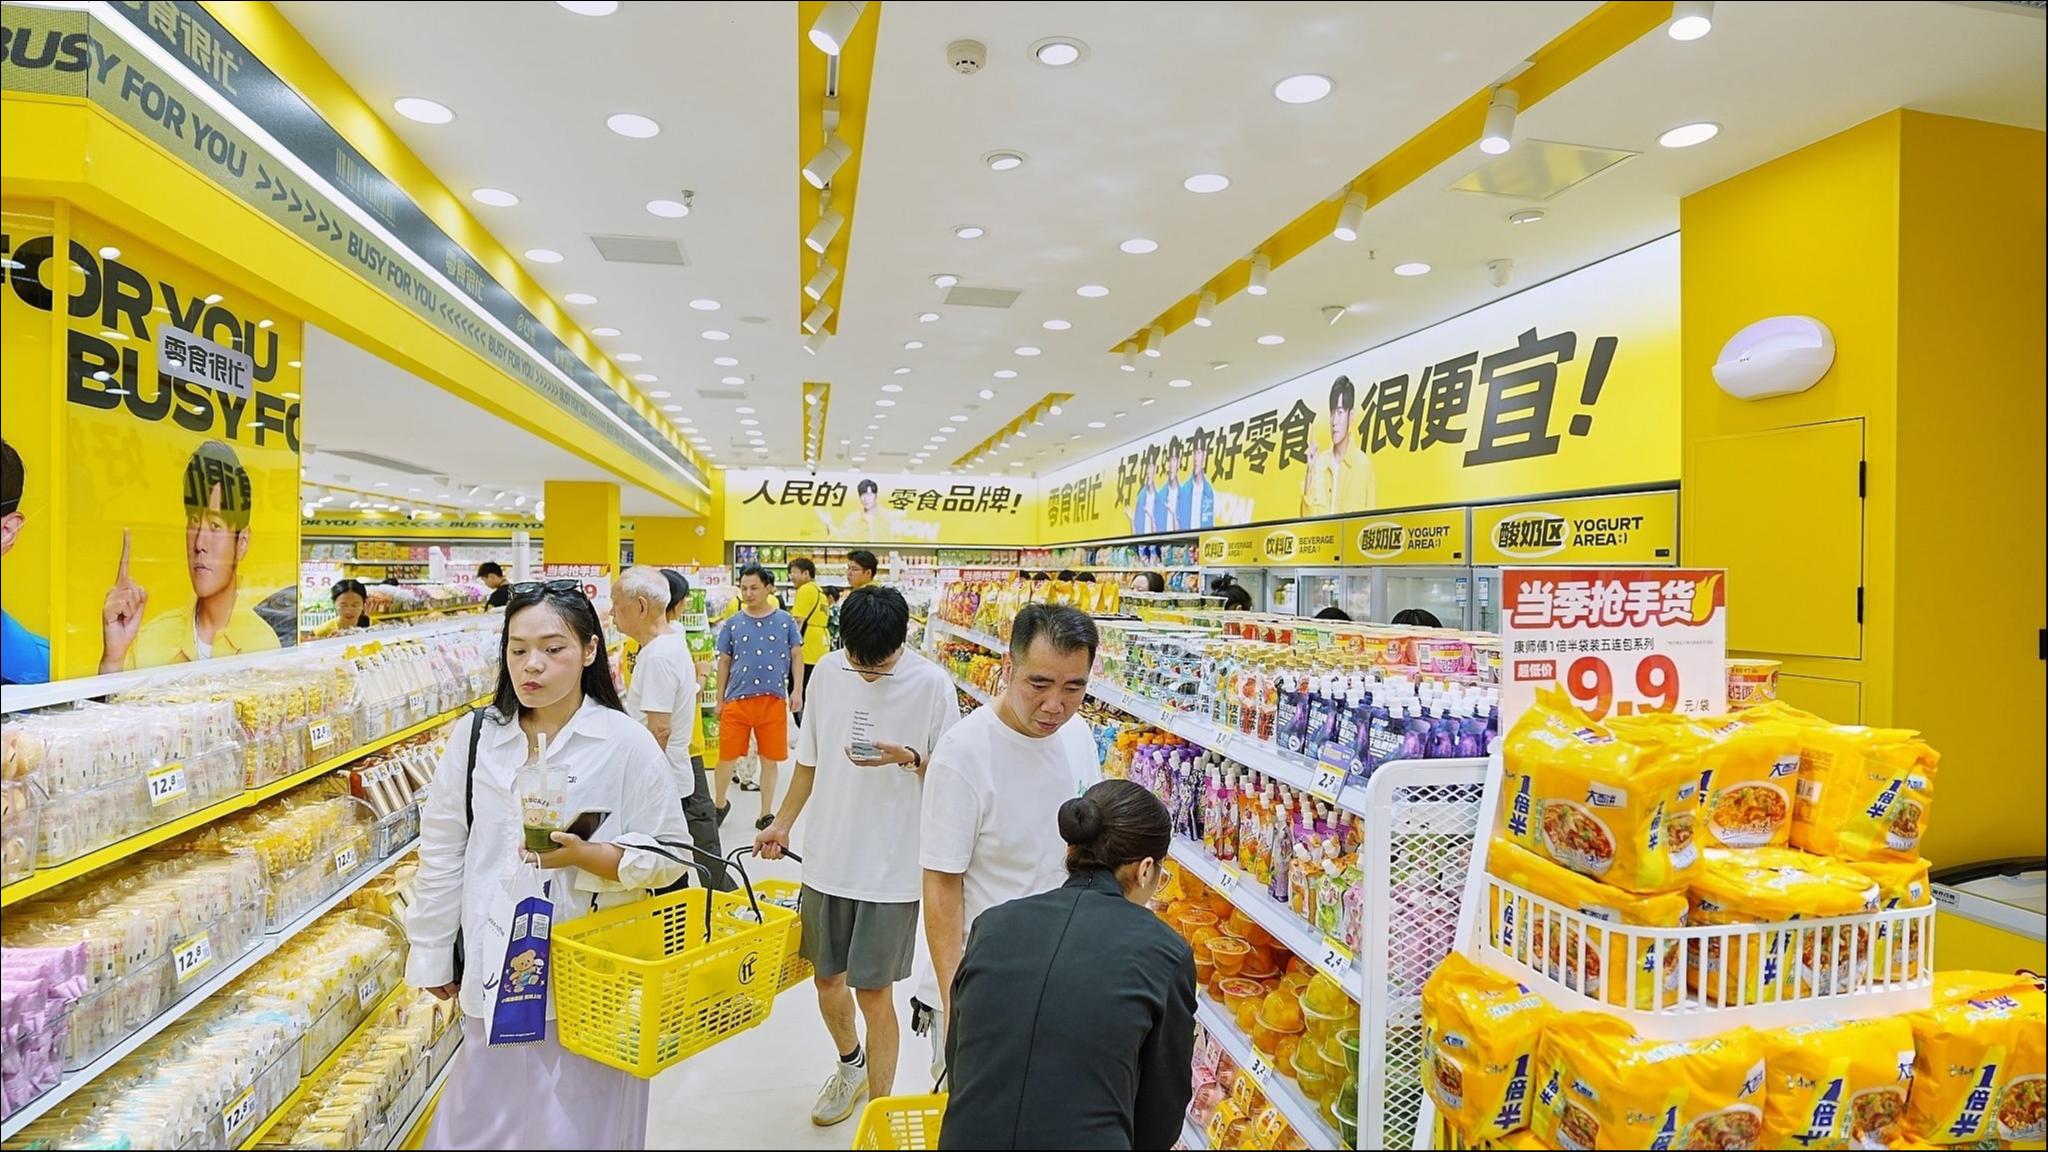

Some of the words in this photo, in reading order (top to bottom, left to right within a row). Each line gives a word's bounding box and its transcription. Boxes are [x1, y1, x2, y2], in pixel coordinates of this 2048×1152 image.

[120, 1, 240, 96] 食很忙
[0, 26, 121, 84] USY
[121, 65, 186, 140] FOR
[192, 112, 247, 178] YOU
[347, 231, 388, 276] BUSY
[387, 262, 412, 296] FOR
[413, 279, 437, 313] YOU
[0, 234, 153, 342] OR
[158, 281, 278, 383] YOU
[164, 335, 245, 390] 零食很忙
[66, 328, 248, 441] BUSY
[1358, 326, 1619, 468] 很便宜!
[742, 479, 848, 507] 人民的
[887, 485, 1023, 514] 零食品牌!
[1048, 474, 1102, 528] 零食很忙
[1299, 535, 1335, 546] BEVERAGE
[1361, 526, 1403, 550] 酸奶区
[1408, 526, 1450, 538] YOGURT
[1498, 518, 1565, 548] 酸奶区
[1573, 517, 1643, 532] YOGURT
[1266, 536, 1293, 555] 饮料区
[1515, 579, 1697, 624] 当季抢手货
[1517, 663, 1554, 678] 超低价
[1567, 655, 1680, 723] 9.9
[1684, 699, 1710, 713] 元/袋
[152, 775, 176, 796] 12.8
[179, 946, 202, 971] 12.8
[1323, 951, 1342, 968] 2.4
[1252, 1059, 1266, 1076] 3.2
[1949, 1064, 1997, 1138] 1倍半
